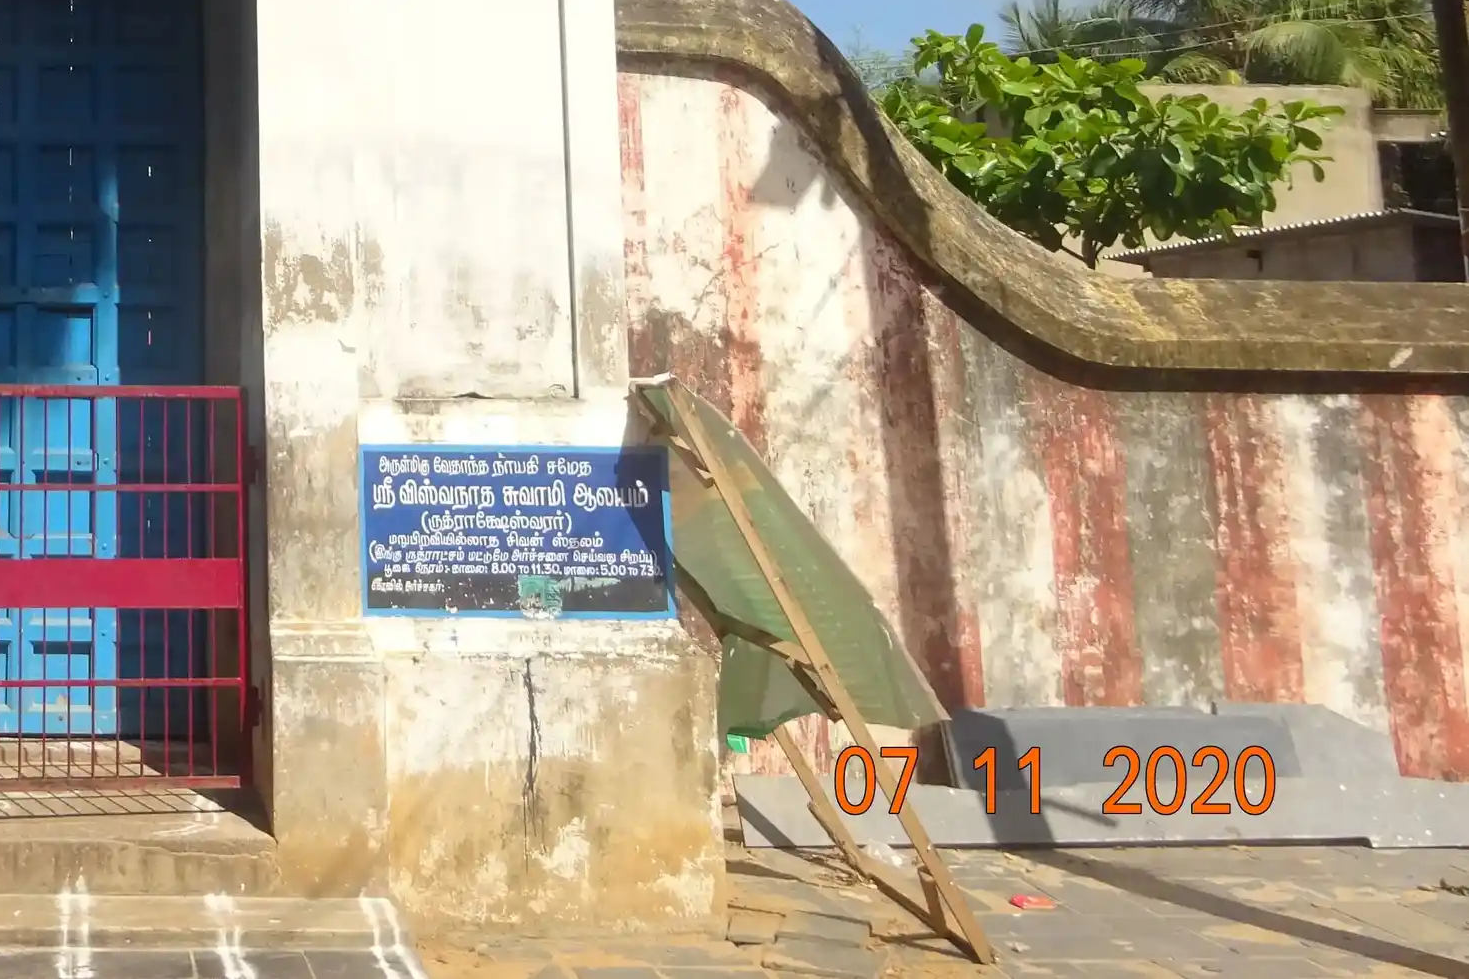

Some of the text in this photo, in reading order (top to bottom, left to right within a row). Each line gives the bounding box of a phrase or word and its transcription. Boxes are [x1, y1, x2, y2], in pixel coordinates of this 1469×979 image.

[379, 453, 592, 477] அருள்மிகு வேதாந்த நாயகி சமேத
[399, 478, 495, 510] விஸ்வநாத
[502, 479, 566, 506] சுவாமி
[573, 479, 649, 511] ஆலயம்
[389, 531, 603, 549] மறுபிறவியில்லாத சிவன் ஸ்தலம்
[491, 564, 516, 574] 8.00
[600, 565, 626, 576] 5.00
